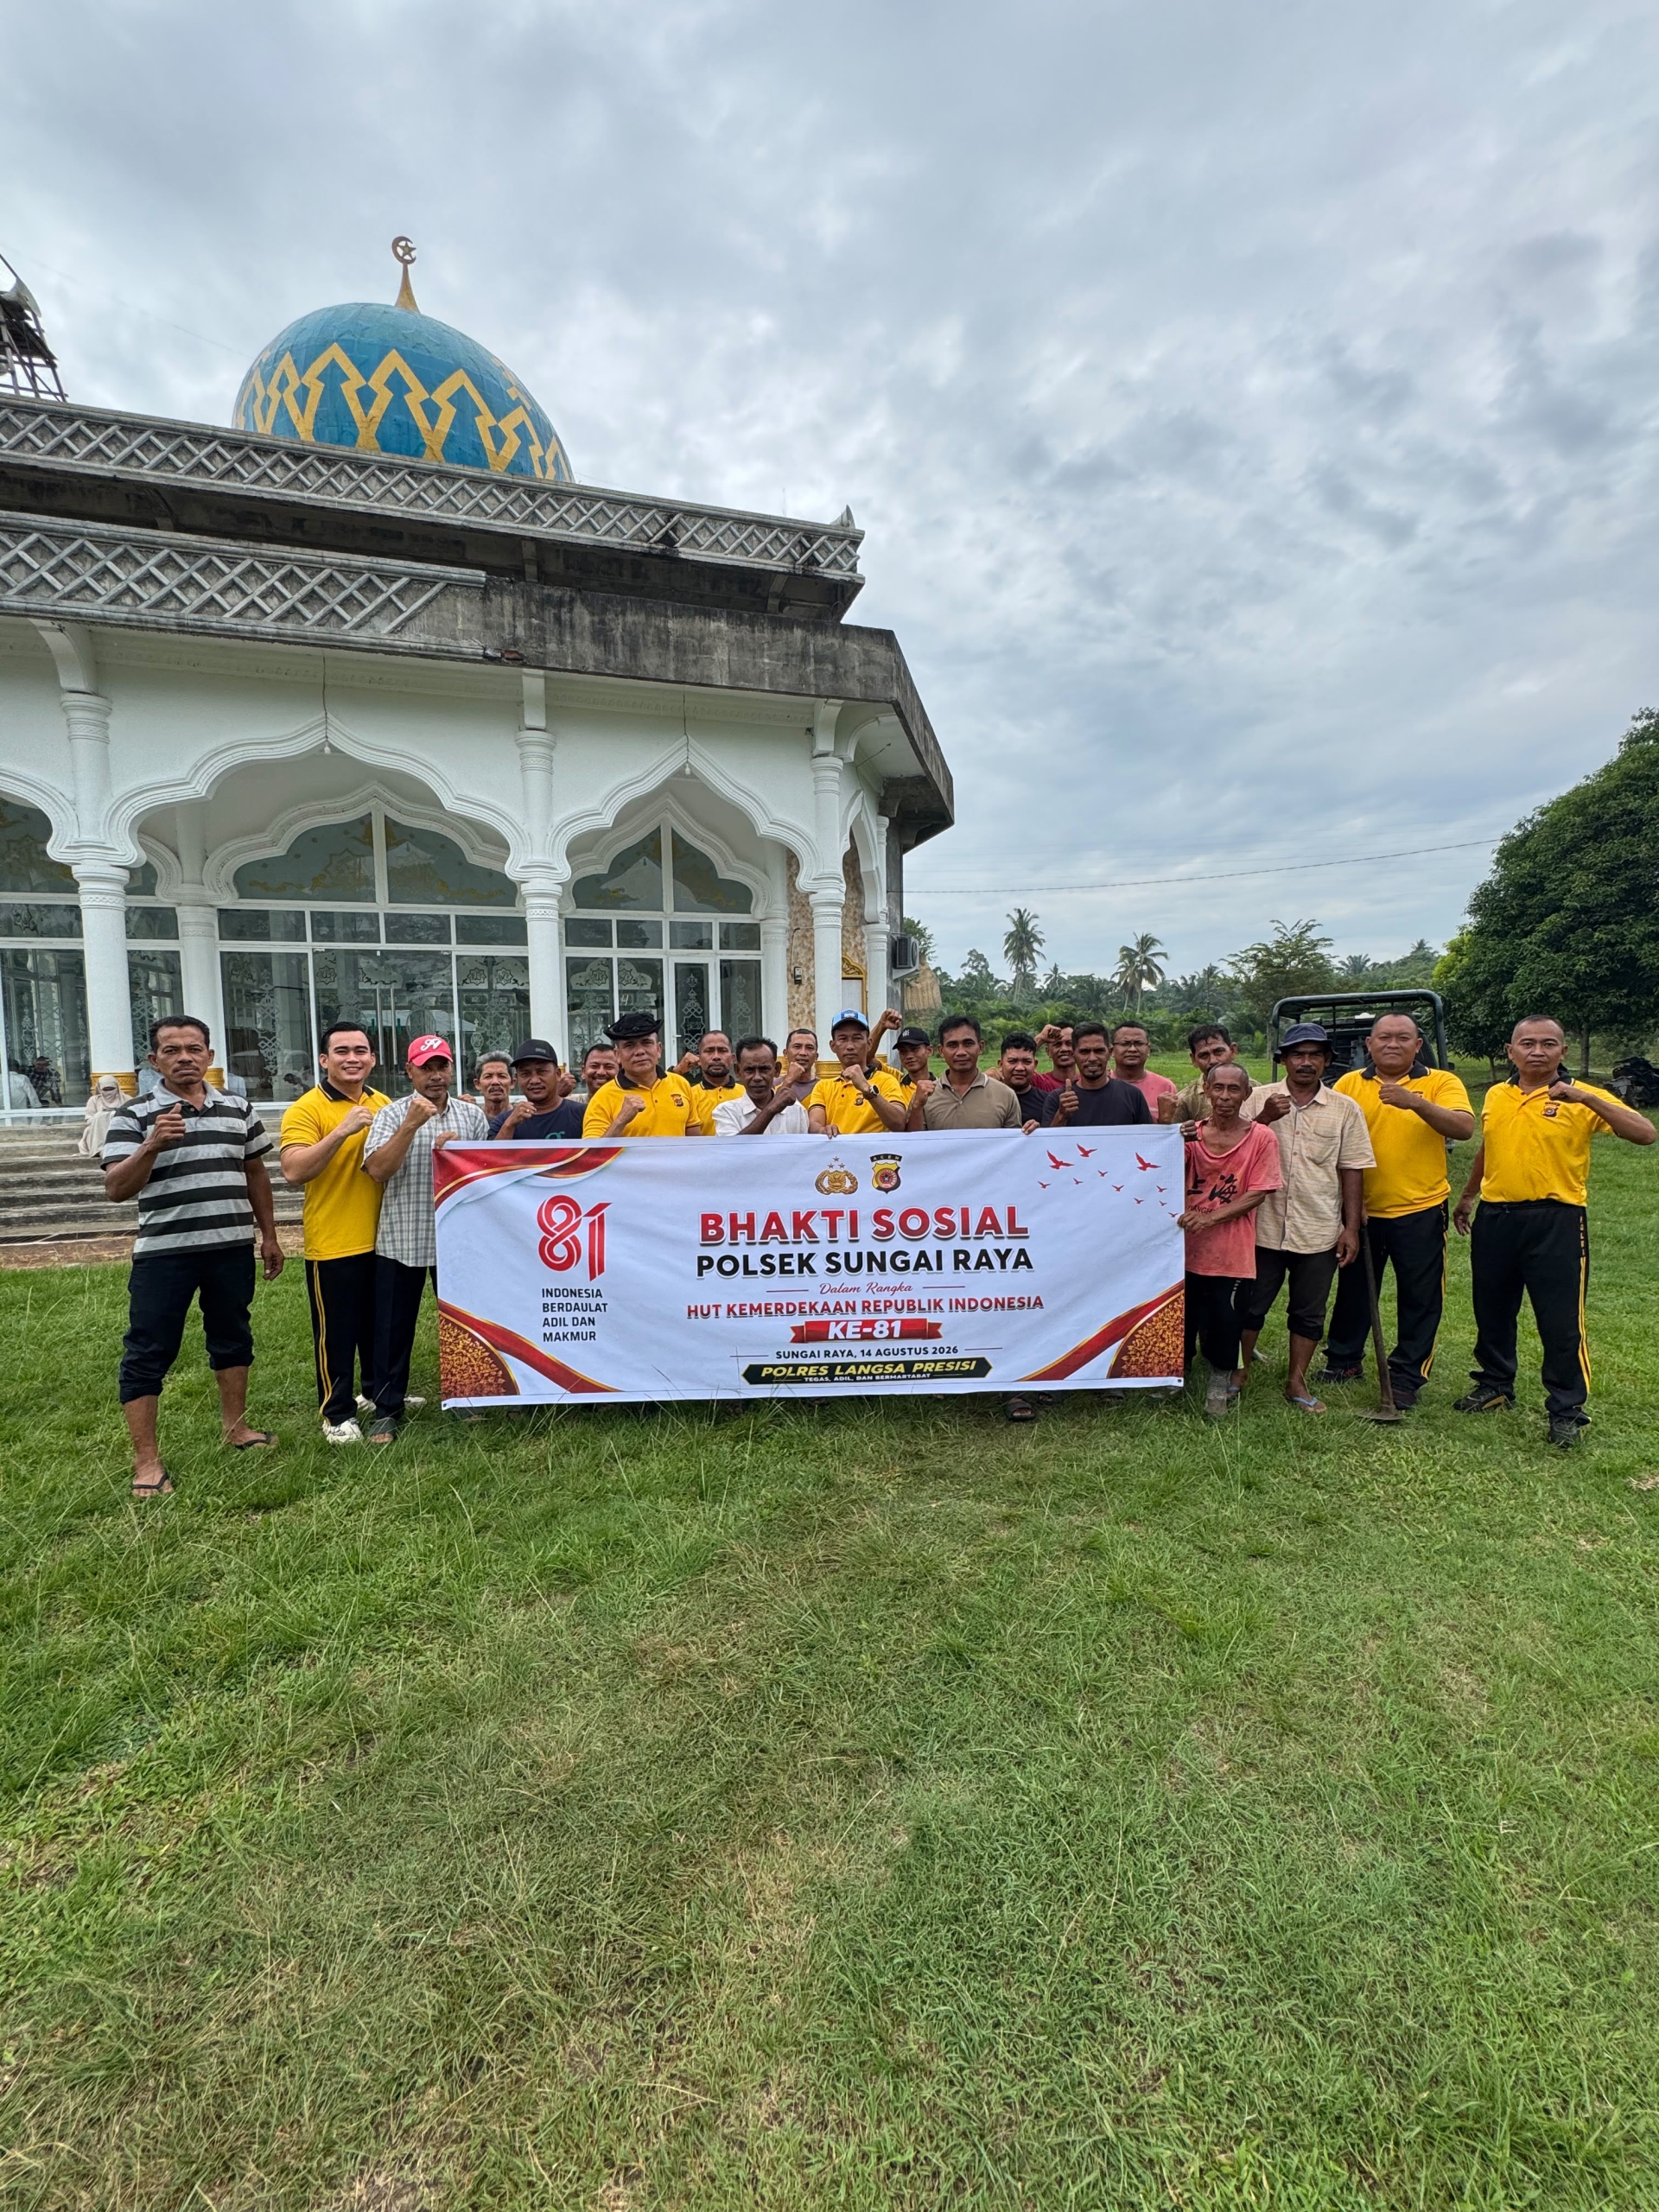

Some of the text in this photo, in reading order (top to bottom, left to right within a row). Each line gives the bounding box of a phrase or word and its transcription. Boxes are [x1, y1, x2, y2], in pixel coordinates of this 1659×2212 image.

[699, 1206, 1029, 1244] BHAKTI SOSIAL
[537, 1194, 613, 1282] 81
[697, 1248, 1033, 1277] POLSEK SUNGAI RAYA
[542, 1288, 603, 1299] INDONESIA
[819, 1281, 913, 1297] Dalam Rangka
[543, 1302, 608, 1313] BERDAULAT
[687, 1295, 1045, 1319] HUT KEMERDEKAAN REPUBLIK INDONESIA
[543, 1317, 596, 1328] ADIL DAN
[828, 1320, 902, 1340] KE-81
[543, 1332, 596, 1343] MAKMUR
[776, 1351, 820, 1359] SUNGAI
[824, 1349, 856, 1359] RAYA,
[875, 1347, 929, 1357] AGUSTUS
[761, 1361, 976, 1376] POLRES LANGSA PRESISI
